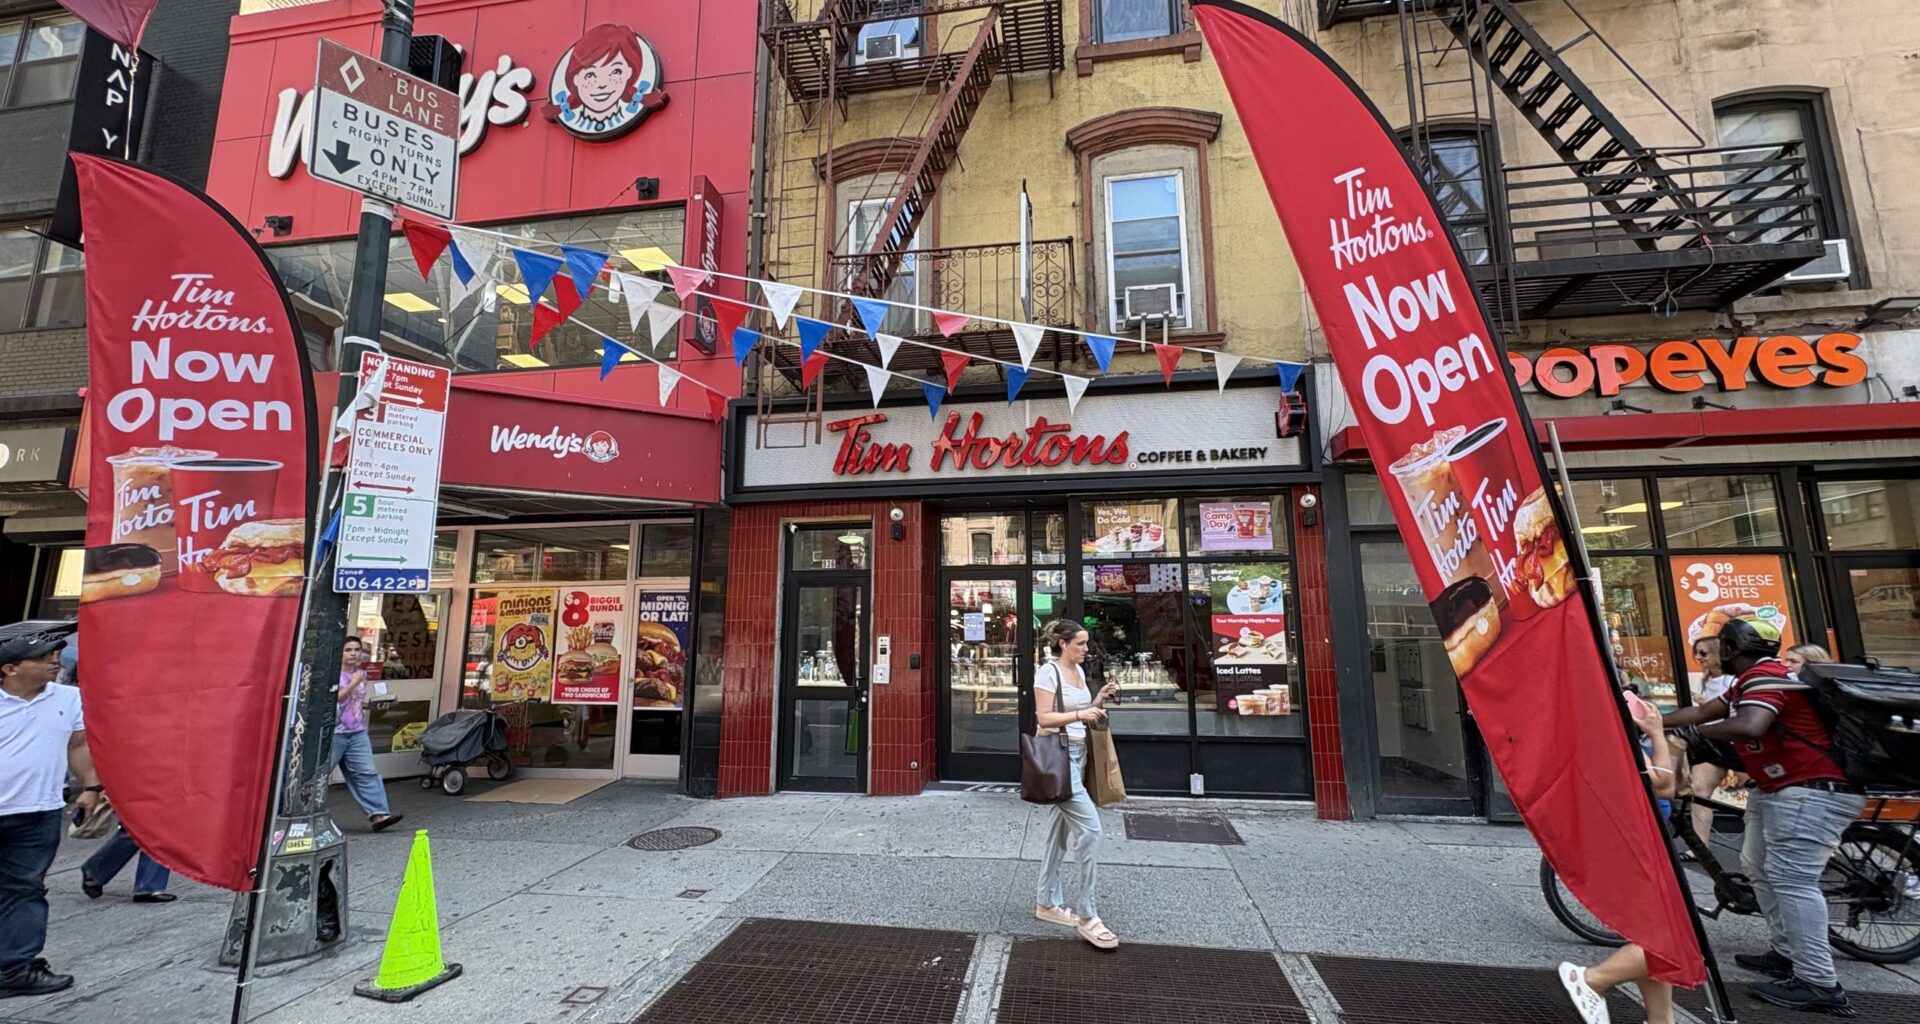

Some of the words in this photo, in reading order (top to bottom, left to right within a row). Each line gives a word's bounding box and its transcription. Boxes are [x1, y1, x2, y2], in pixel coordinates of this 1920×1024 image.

[396, 78, 439, 109] BUS
[388, 94, 445, 131] LANE
[343, 103, 434, 151] BUSES
[348, 126, 390, 149] RIGHT
[399, 145, 443, 168] TURNS
[370, 148, 441, 186] ONLY
[357, 174, 399, 197] EXCEPT
[1333, 167, 1393, 220] Tim
[1330, 213, 1427, 270] Hortons
[171, 273, 235, 306] Tim
[132, 298, 267, 333] Hortons
[1343, 269, 1456, 350] Now
[131, 337, 275, 384] Now
[386, 361, 436, 379] STANDING
[391, 373, 408, 383] 7pm
[1362, 332, 1495, 427] Open
[394, 382, 424, 396] Sunday
[106, 387, 292, 441] Open
[388, 405, 405, 413] hour
[387, 419, 414, 430] parking
[388, 412, 418, 423] metered
[358, 428, 424, 445] COMMERCIAL
[490, 424, 583, 459] Wendy's
[826, 412, 912, 476] Tim
[930, 410, 1130, 472] Hortons
[1137, 450, 1193, 465] COFFEE
[1195, 449, 1207, 462] &
[1209, 446, 1268, 462] BAKERY
[408, 446, 434, 456] ONLY
[354, 458, 371, 468] 7am
[380, 462, 399, 472] 4pm
[353, 468, 384, 479] Except
[386, 471, 417, 483] Sunday
[119, 478, 162, 511] Tim
[180, 490, 257, 532] Tim
[352, 495, 368, 516] 5
[377, 506, 408, 514] metered
[1416, 489, 1460, 538] Tim
[1471, 477, 1517, 541] Tim
[376, 513, 404, 522] parking
[1111, 515, 1131, 524] Cold
[1204, 511, 1233, 521] Camp
[347, 524, 365, 533] 7pm
[373, 526, 409, 536] Midnight
[1209, 520, 1229, 529] Day
[345, 534, 375, 544] Except
[377, 535, 409, 547] Sunday
[338, 577, 407, 590] 106422
[1718, 574, 1775, 586] CHEESE
[590, 596, 621, 605] BIGGIE
[1720, 587, 1759, 599] BITES
[500, 596, 552, 611] minions
[589, 603, 624, 612] BUNDLE
[640, 611, 660, 622] OR
[1215, 667, 1234, 675] Iced
[1235, 667, 1262, 675] Lattes
